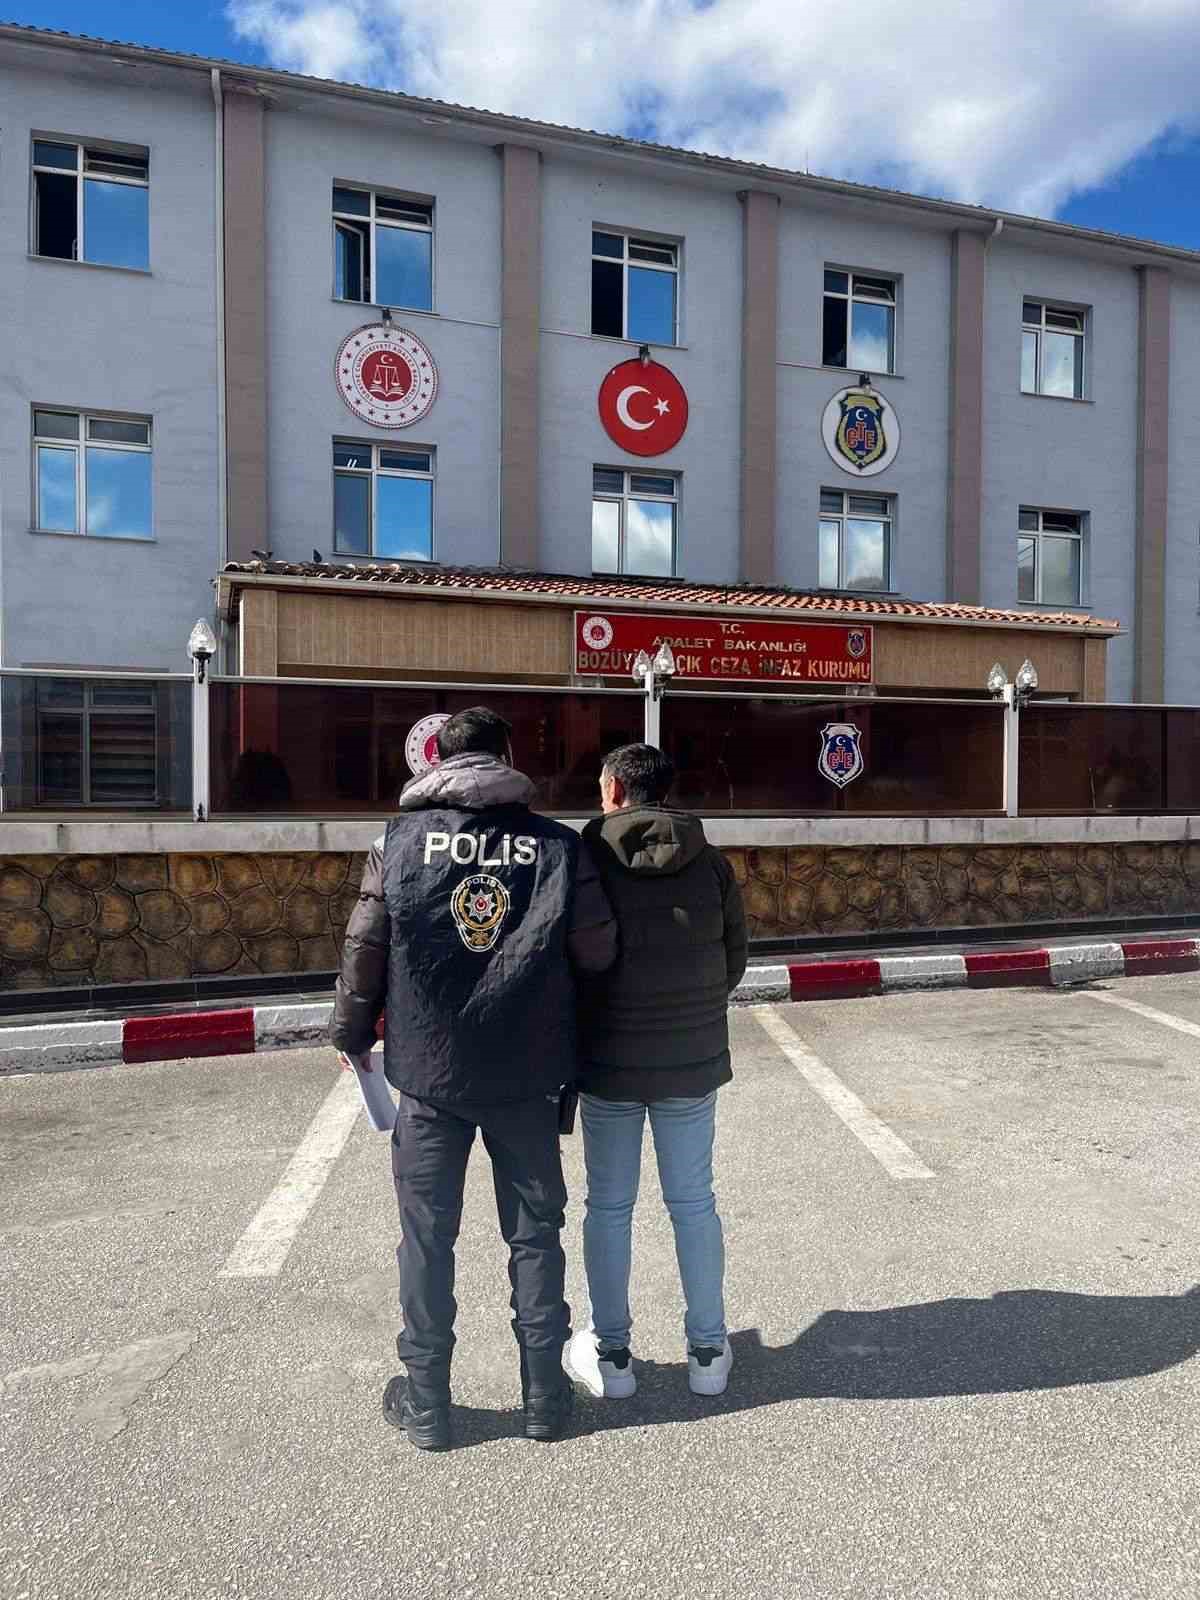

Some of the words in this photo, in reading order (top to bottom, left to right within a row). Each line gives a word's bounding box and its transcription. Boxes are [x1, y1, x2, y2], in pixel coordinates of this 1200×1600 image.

[719, 622, 745, 635] T.C.
[651, 635, 715, 650] ADALET
[710, 655, 751, 676] CEZA
[759, 654, 801, 677] İNFAZ
[807, 659, 870, 680] KURUMU
